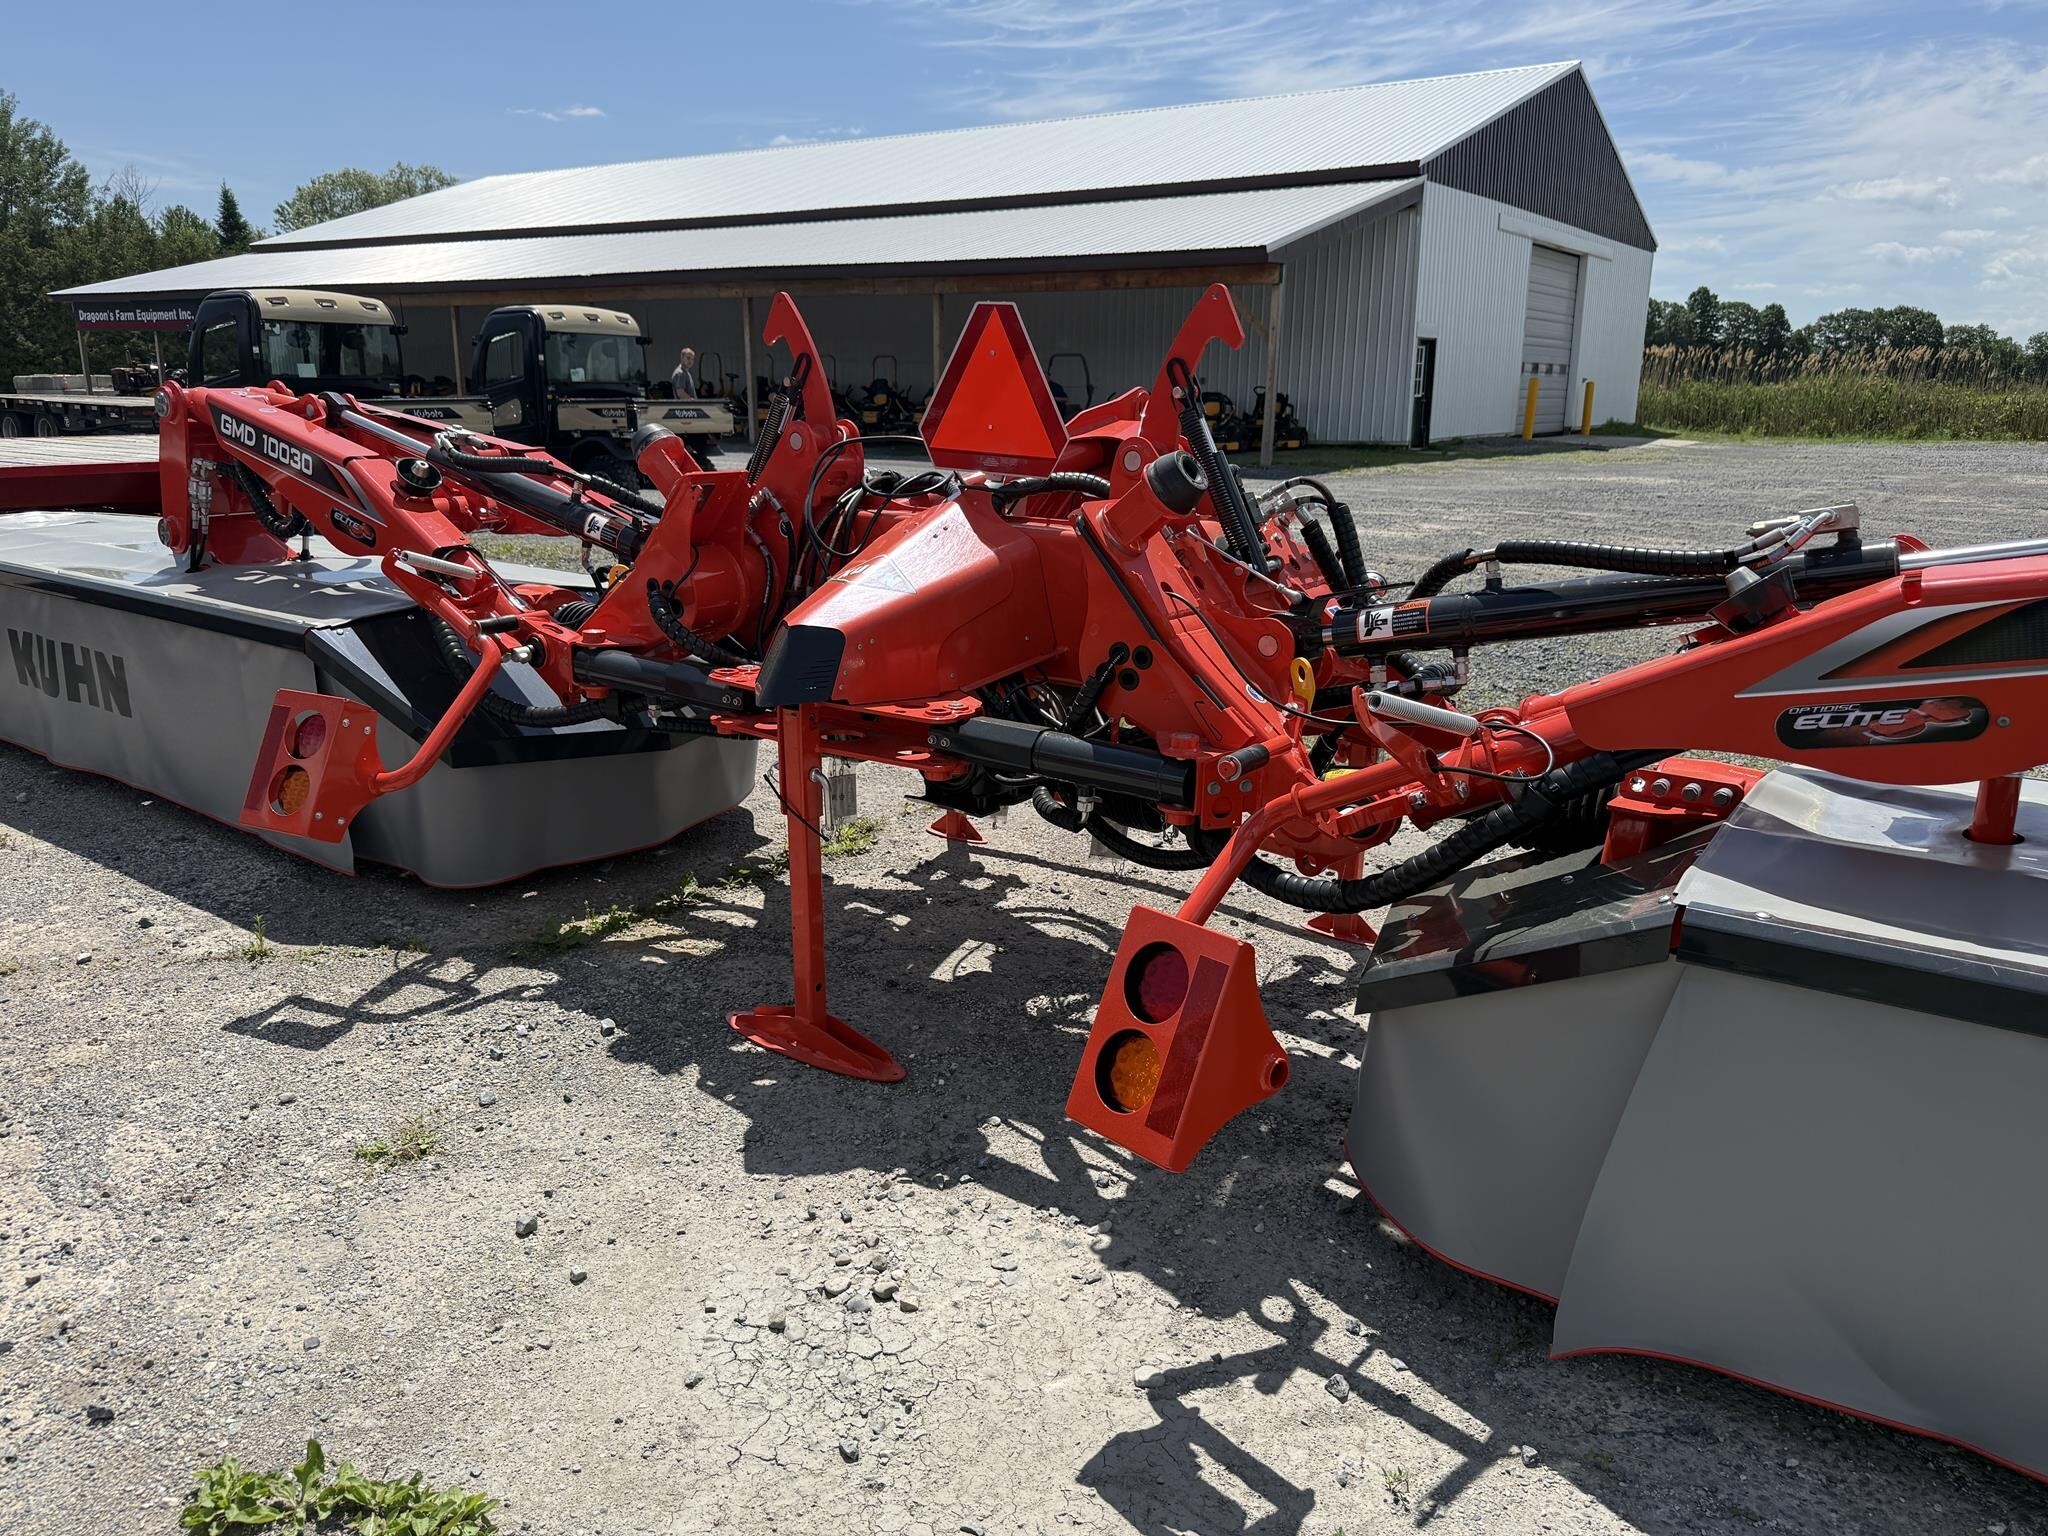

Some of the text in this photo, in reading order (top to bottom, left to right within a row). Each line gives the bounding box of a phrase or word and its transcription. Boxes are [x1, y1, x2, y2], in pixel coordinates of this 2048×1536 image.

[79, 308, 195, 323] Dragoon's Farm Equipment Inc.
[413, 409, 444, 418] Kubota
[602, 408, 626, 417] Kubota
[675, 410, 698, 418] Kubota
[221, 413, 313, 475] GMD 10030
[333, 512, 361, 529] ELITE
[7, 628, 133, 718] KUHN
[1789, 704, 1860, 715] OPTIDISC
[1793, 708, 1911, 730] ELITE
